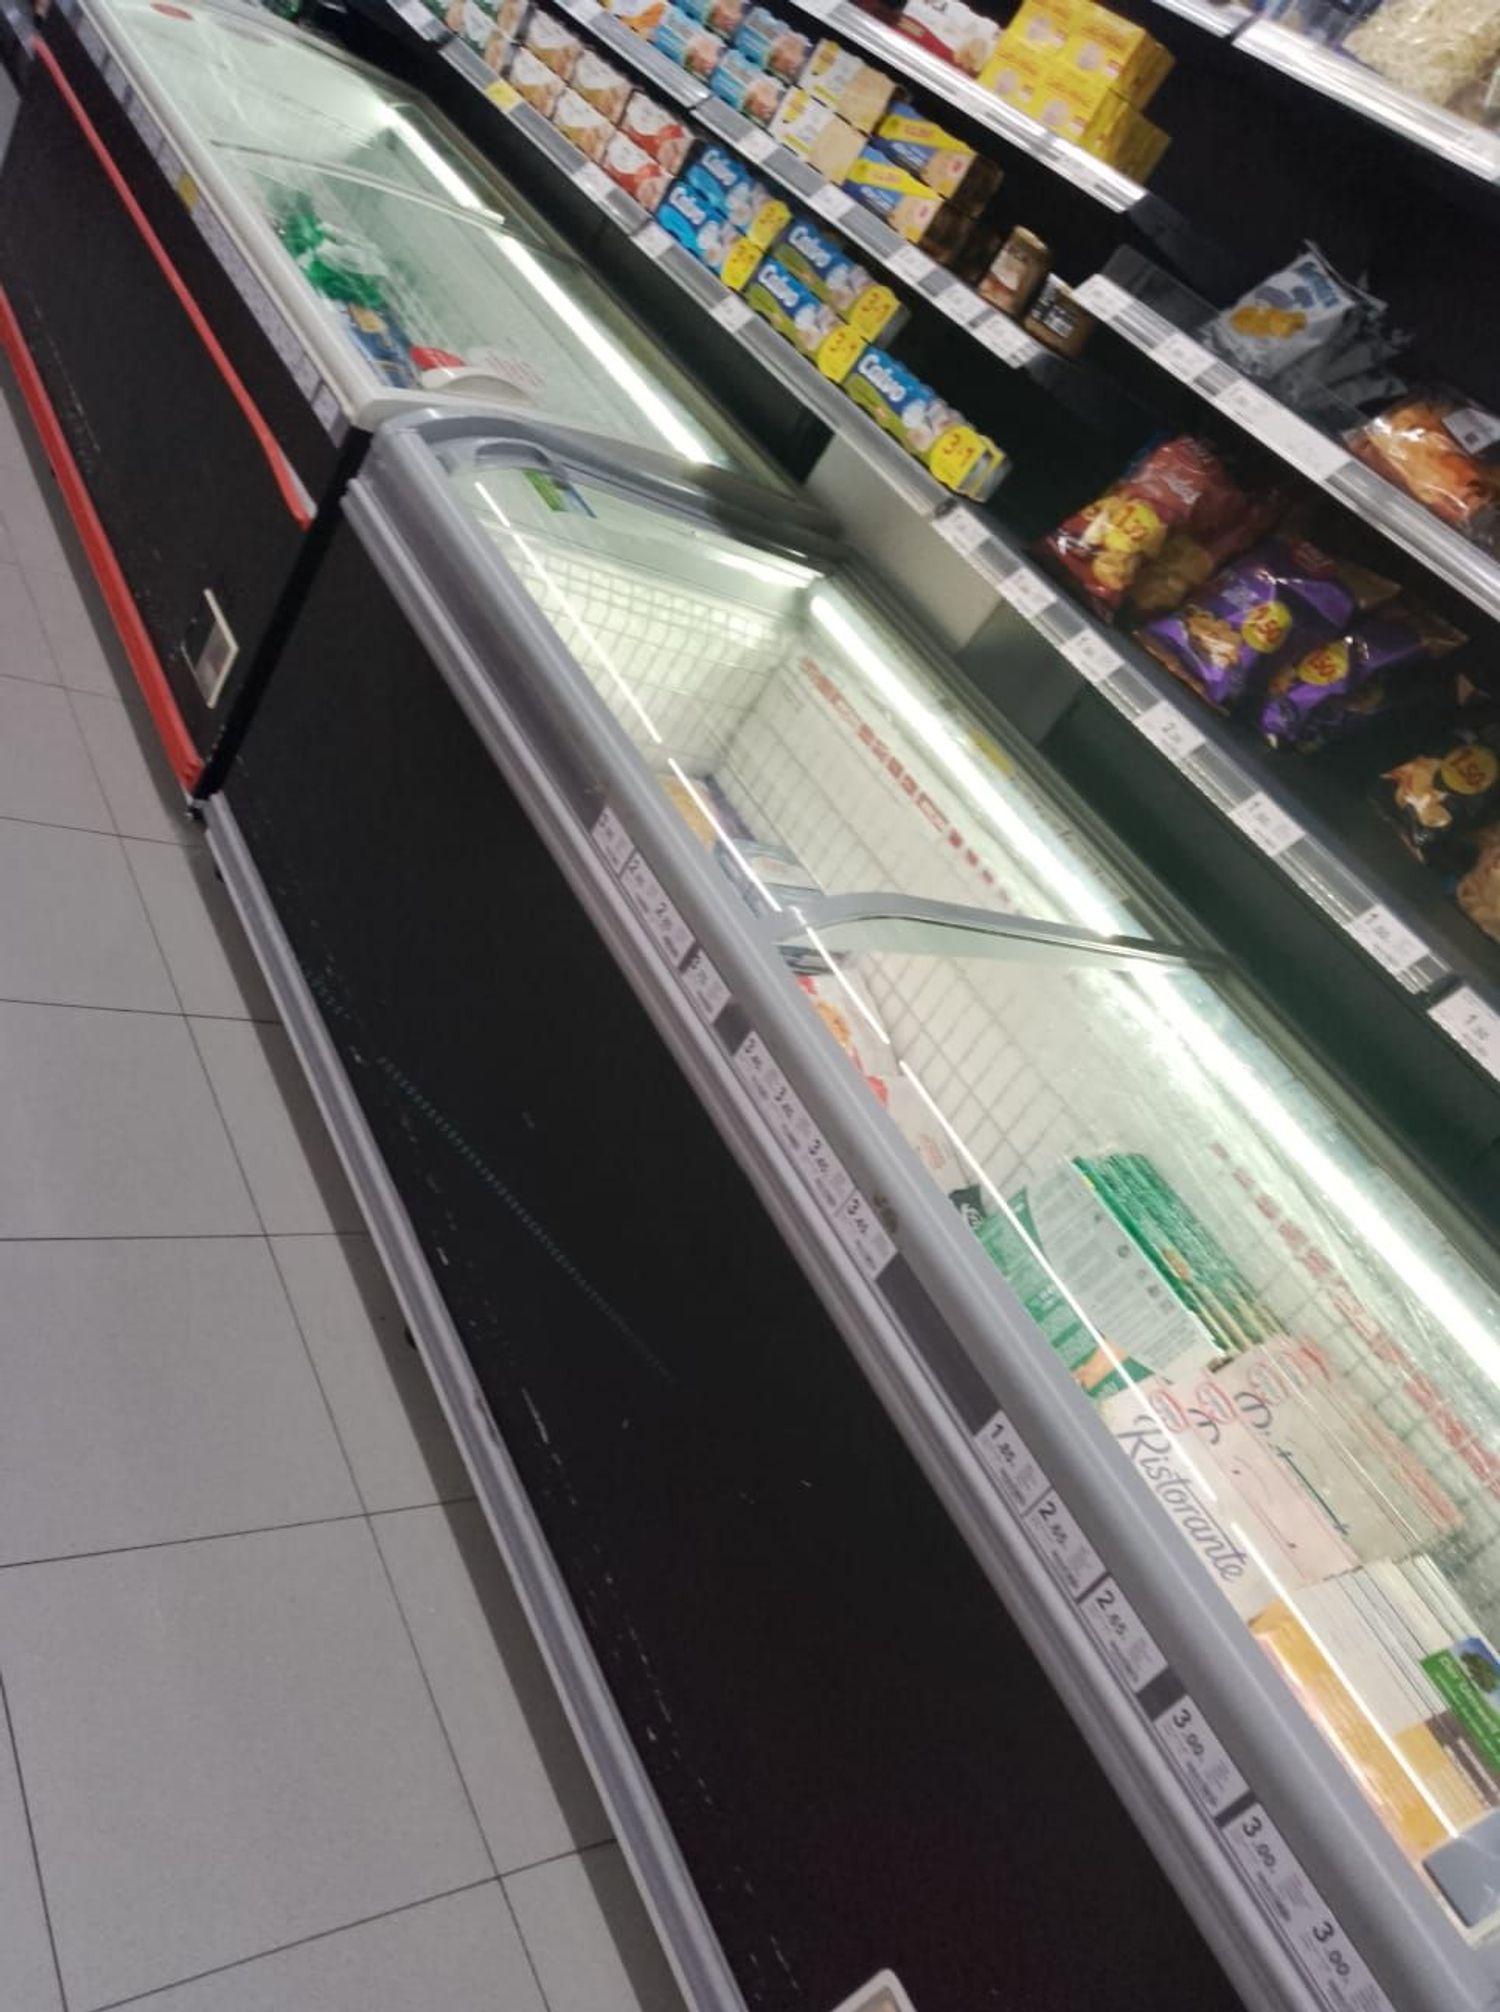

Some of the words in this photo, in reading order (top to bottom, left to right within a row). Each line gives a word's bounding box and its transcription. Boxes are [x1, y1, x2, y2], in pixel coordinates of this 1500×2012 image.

[789, 226, 832, 268] Calvo
[758, 264, 800, 307] Calvo
[858, 354, 906, 402] Calvo
[1118, 1415, 1246, 1581] Ristorante
